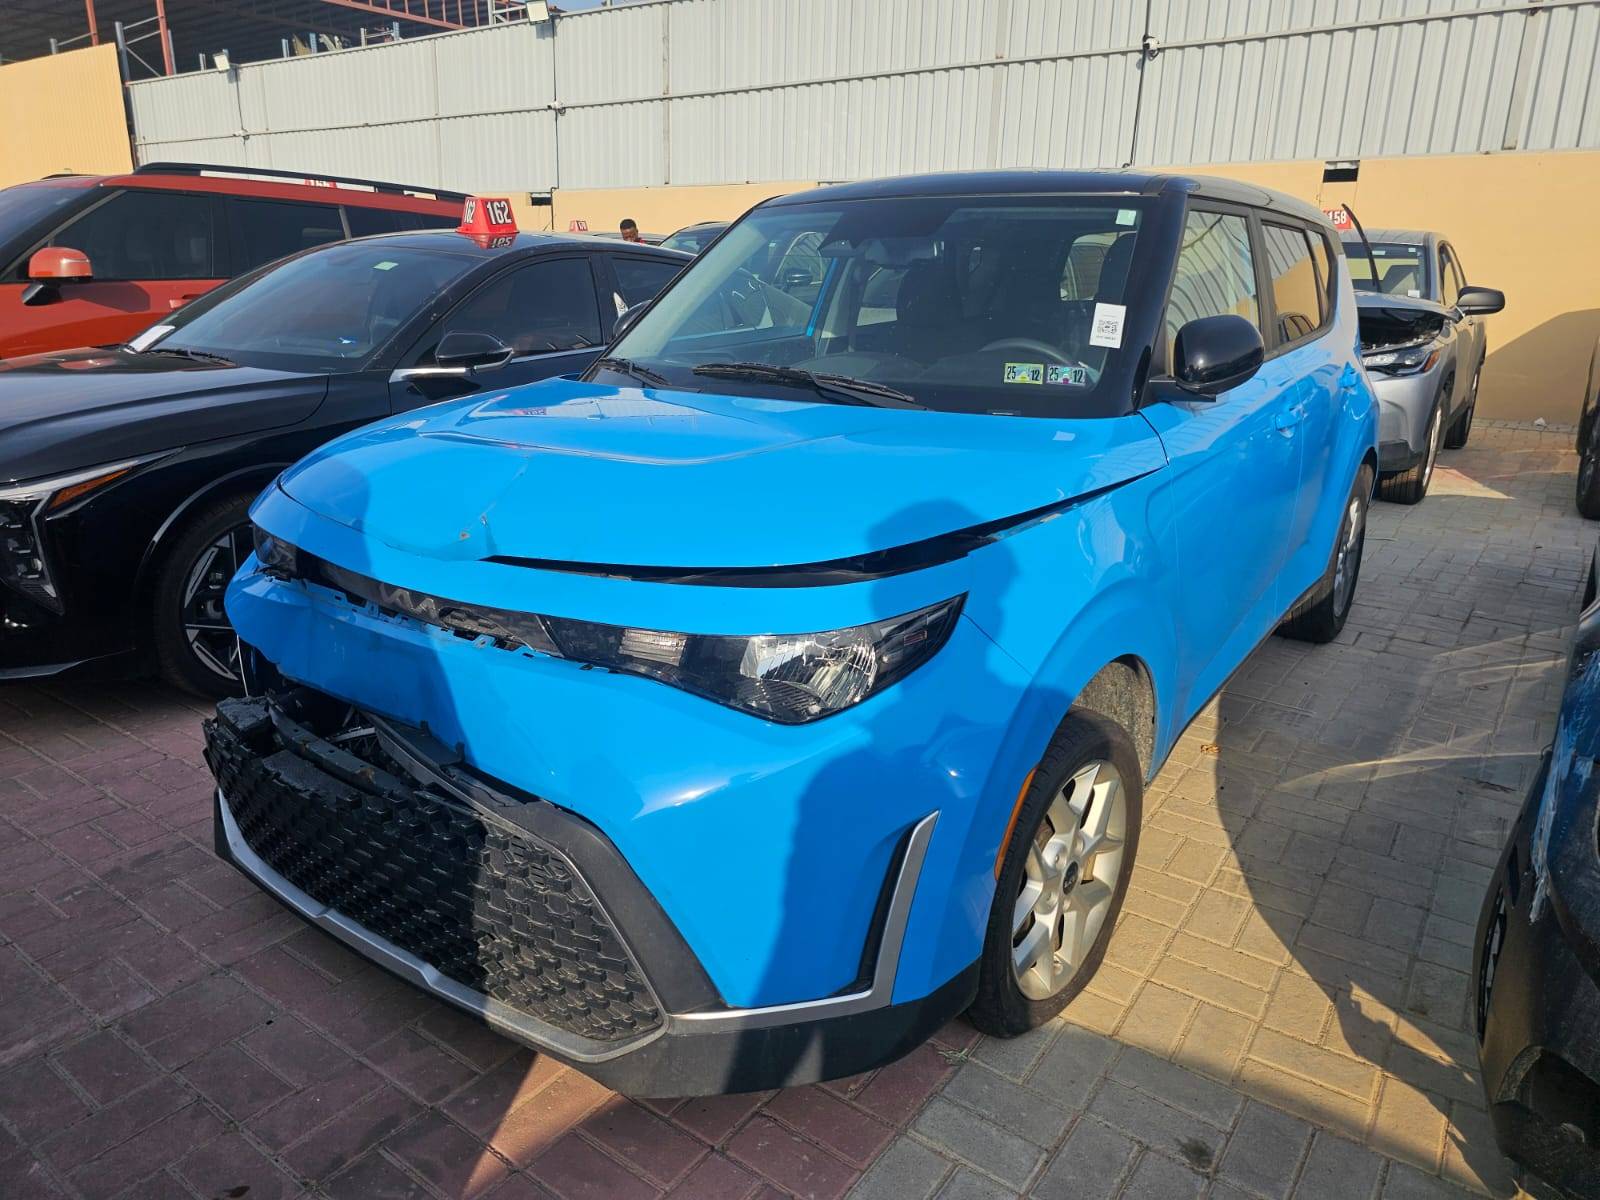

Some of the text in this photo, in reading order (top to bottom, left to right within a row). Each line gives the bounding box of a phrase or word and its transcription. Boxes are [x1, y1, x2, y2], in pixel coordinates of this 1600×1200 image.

[486, 200, 512, 225] 162
[1327, 210, 1347, 225] 158
[1006, 366, 1040, 381] 25 12
[1049, 367, 1083, 383] 25 12
